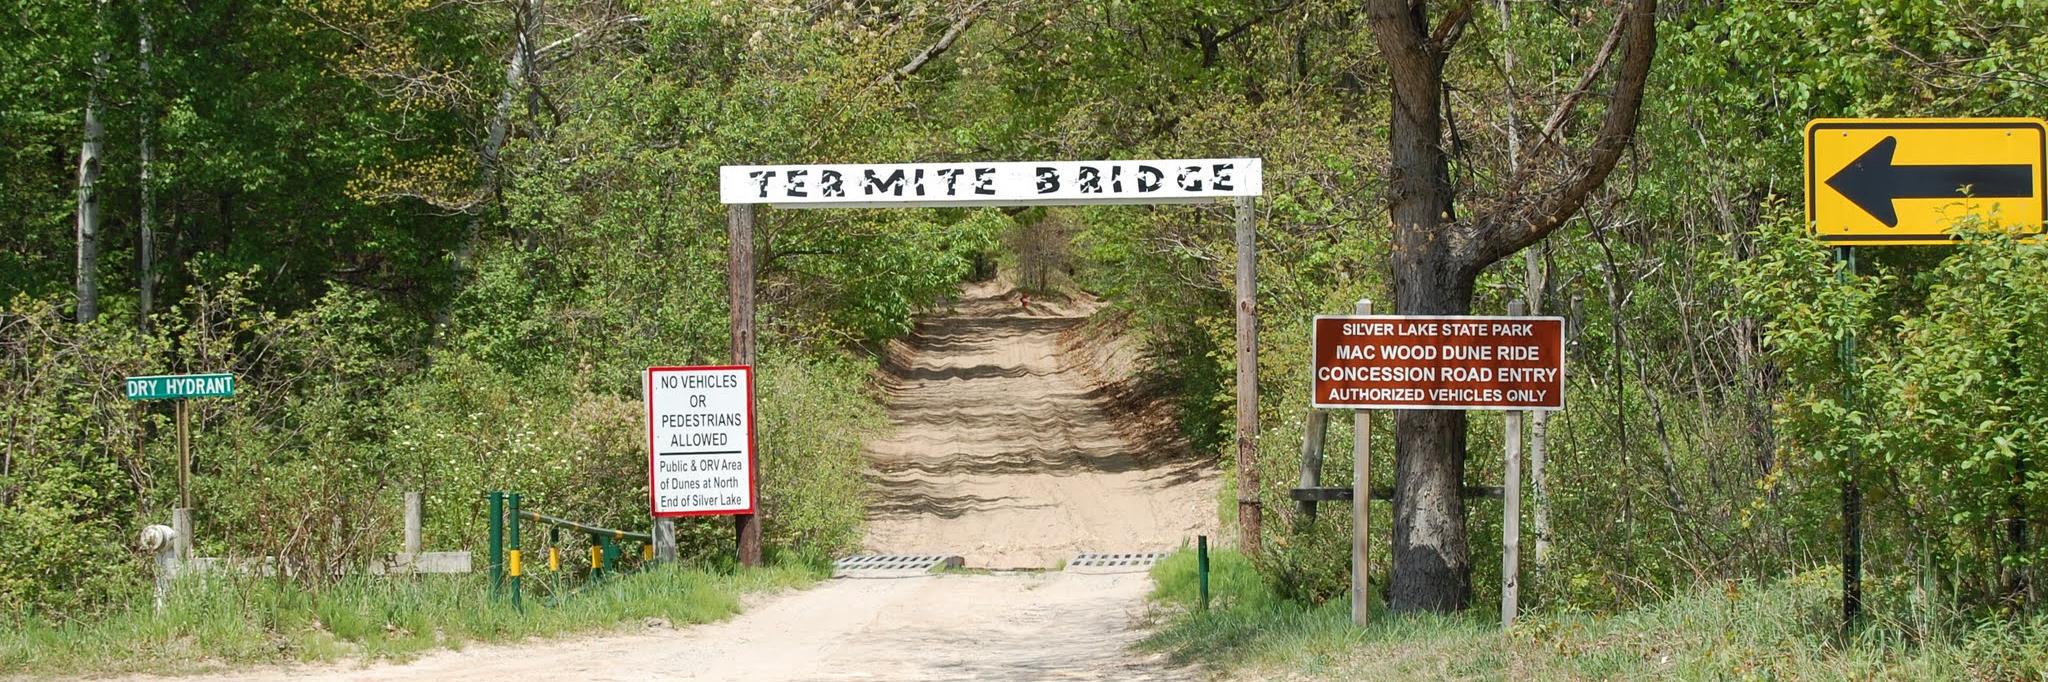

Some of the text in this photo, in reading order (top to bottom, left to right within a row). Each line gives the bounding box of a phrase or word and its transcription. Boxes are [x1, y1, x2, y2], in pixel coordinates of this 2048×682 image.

[749, 164, 1234, 198] TERMITE BRIDGE
[1342, 323, 1533, 336] SILVER LAKE STATE PARK
[1336, 345, 1539, 360] MAC WOOD DUNE RIDE
[661, 374, 738, 389] NO VEHICLES
[1318, 366, 1557, 382] CONCESSION ROAD ENTRY
[128, 377, 232, 397] DRY HYDRANT
[689, 394, 706, 408] OR
[1328, 388, 1547, 402] AUTHORIZED VEHICLES ONLY
[661, 413, 742, 428] PEDESTRIANS
[670, 433, 728, 447] ALLOWED
[660, 459, 742, 472] Public & ORV Area
[660, 476, 739, 490] of Dunes at North
[660, 493, 741, 508] End of Silver Lake
